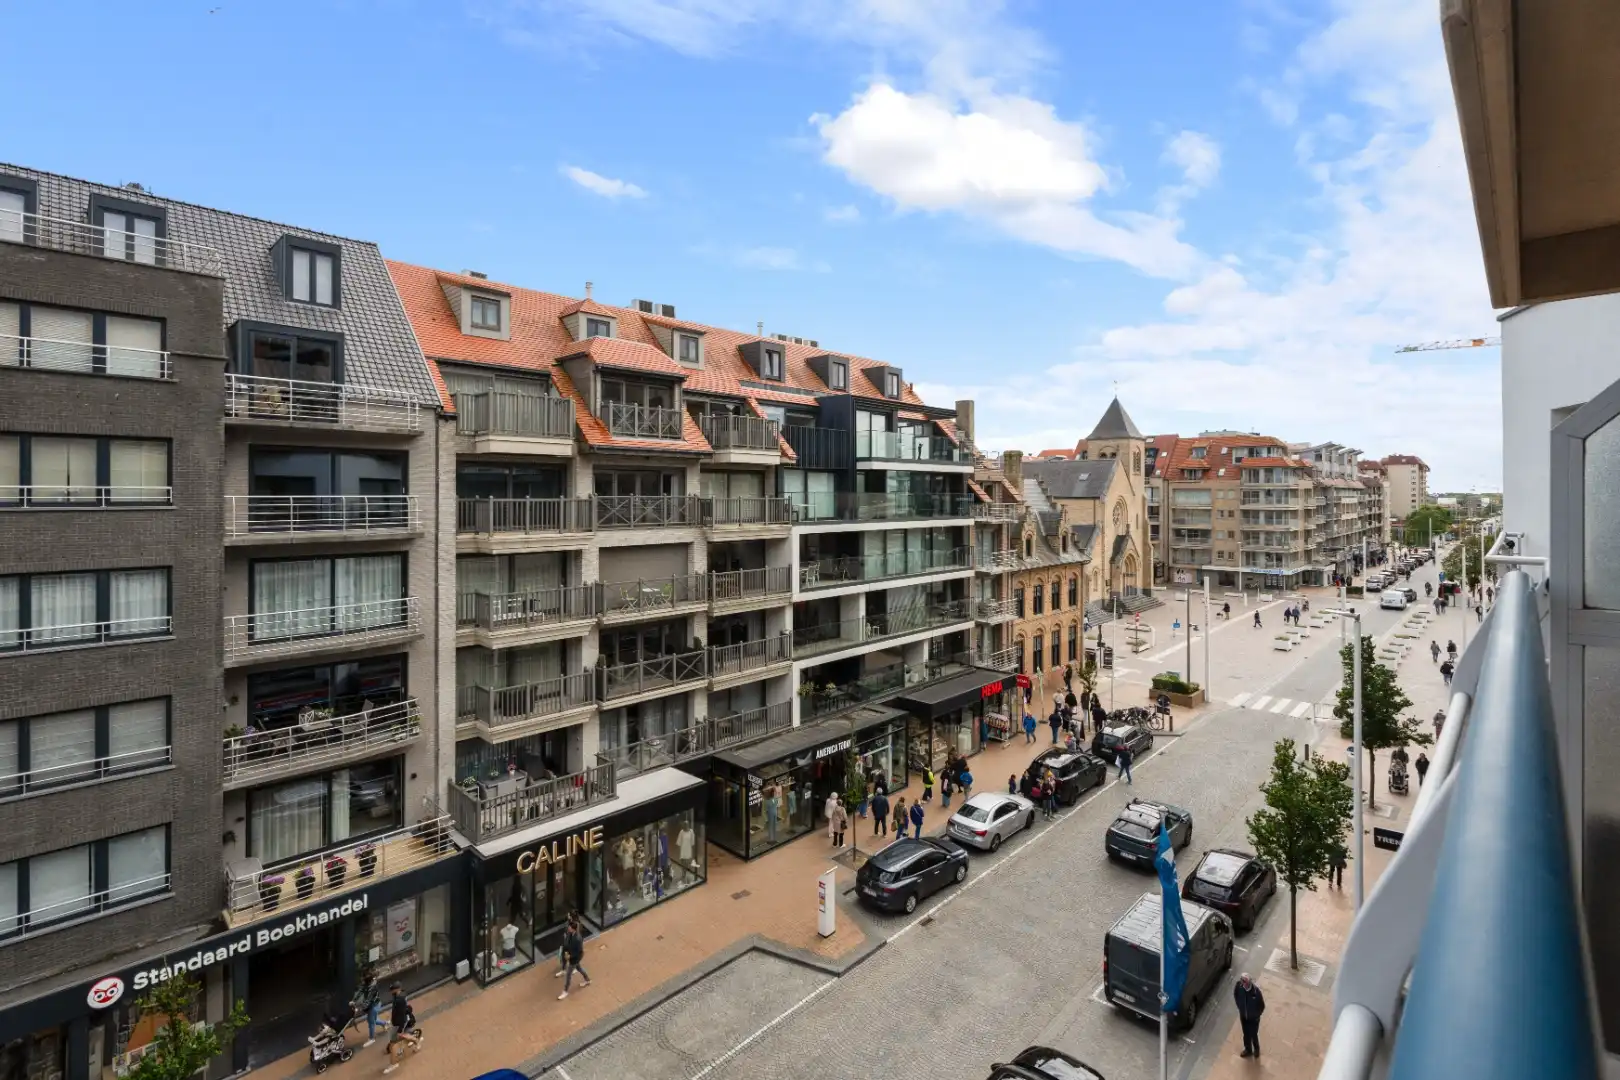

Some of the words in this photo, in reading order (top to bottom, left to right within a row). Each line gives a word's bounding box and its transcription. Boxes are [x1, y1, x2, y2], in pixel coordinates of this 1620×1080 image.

[981, 680, 1003, 697] HEMA
[815, 743, 838, 760] AMERICA
[516, 824, 604, 875] CALINE
[132, 934, 251, 990] Standaard
[256, 893, 368, 947] Boekhandel
